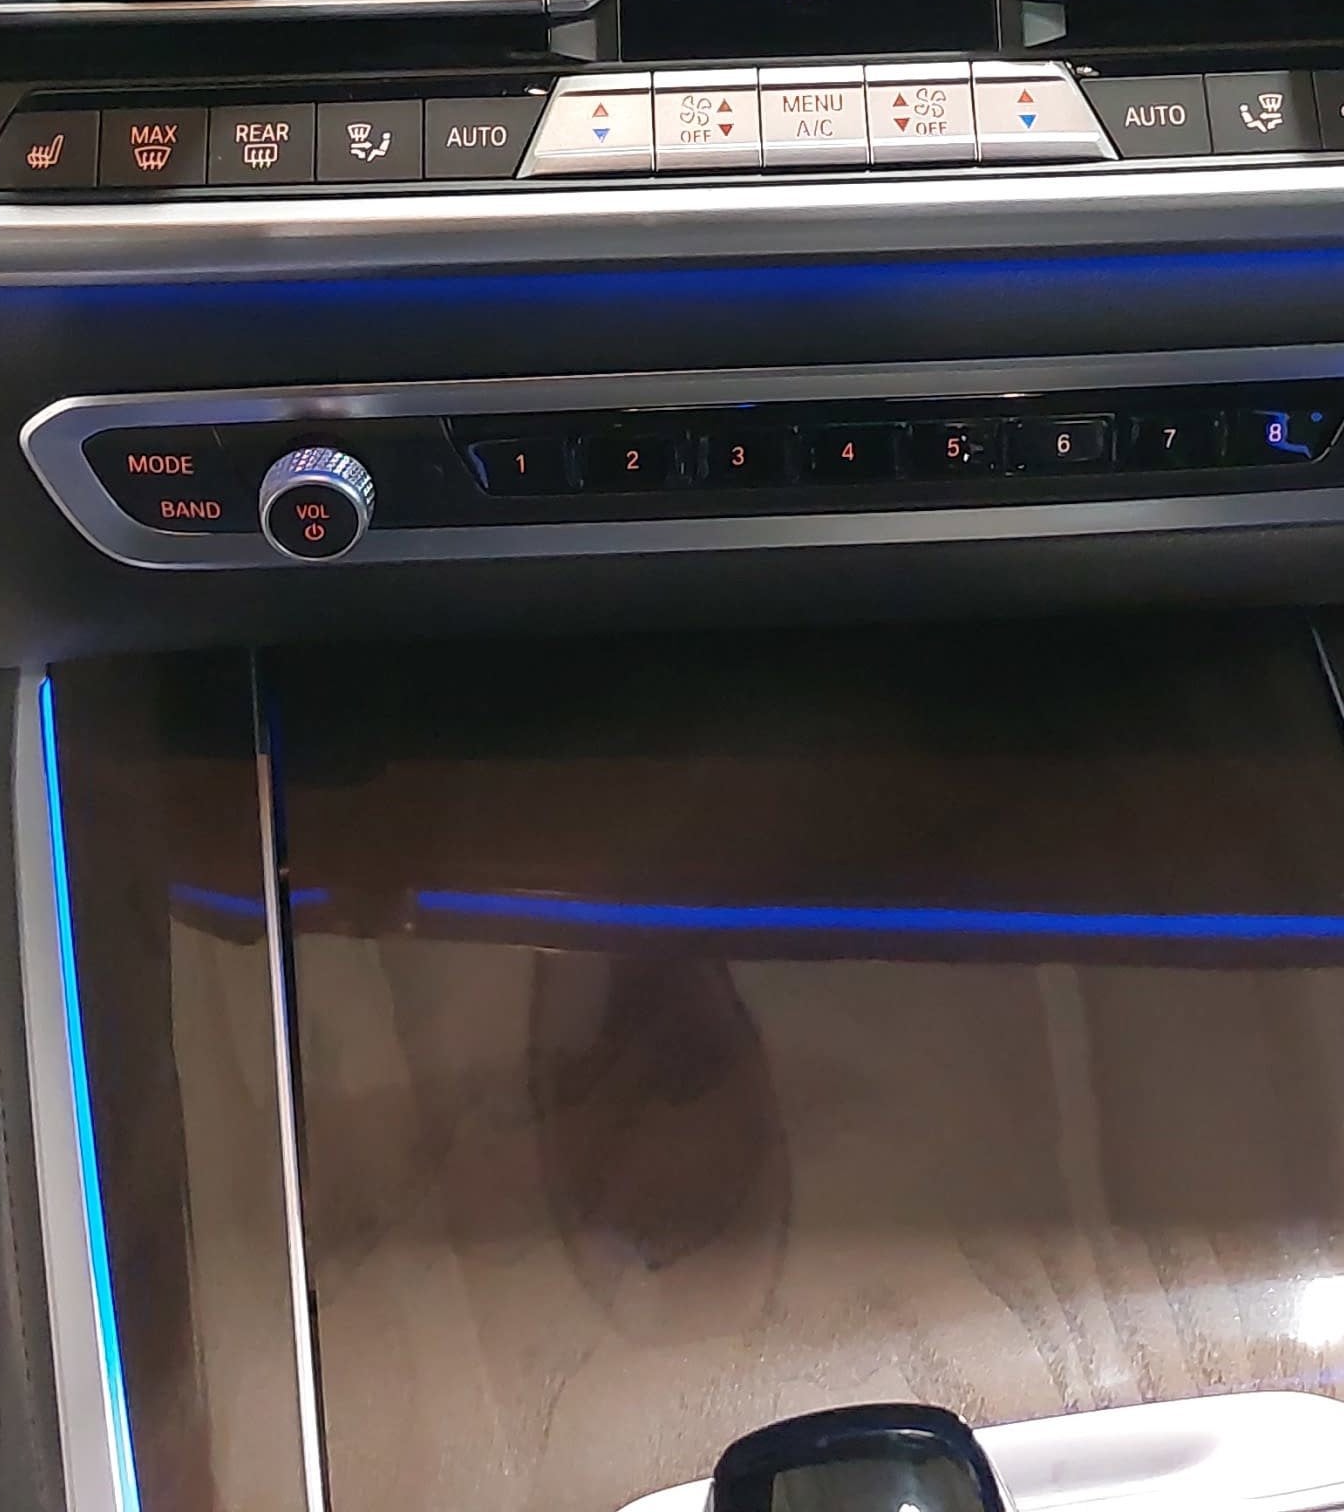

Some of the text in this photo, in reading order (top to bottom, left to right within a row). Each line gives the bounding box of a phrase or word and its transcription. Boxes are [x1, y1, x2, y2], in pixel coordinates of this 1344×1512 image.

[782, 94, 843, 113] MENU
[1124, 104, 1186, 128] AUTO
[130, 124, 178, 144] MAX
[235, 122, 289, 143] REAR
[446, 125, 507, 148] AUTO
[679, 129, 712, 144] OFF
[796, 119, 833, 137] A/C
[915, 121, 948, 136] OFF
[1163, 428, 1177, 448] 7
[1268, 423, 1282, 443] 8
[841, 442, 855, 461] 4
[946, 438, 960, 458] 5
[1056, 434, 1070, 454] 6
[127, 454, 194, 475] MODE
[516, 454, 526, 474] 1
[626, 450, 640, 470] 2
[731, 446, 745, 466] 3
[160, 500, 221, 519] BAND
[296, 504, 330, 520] VOL
